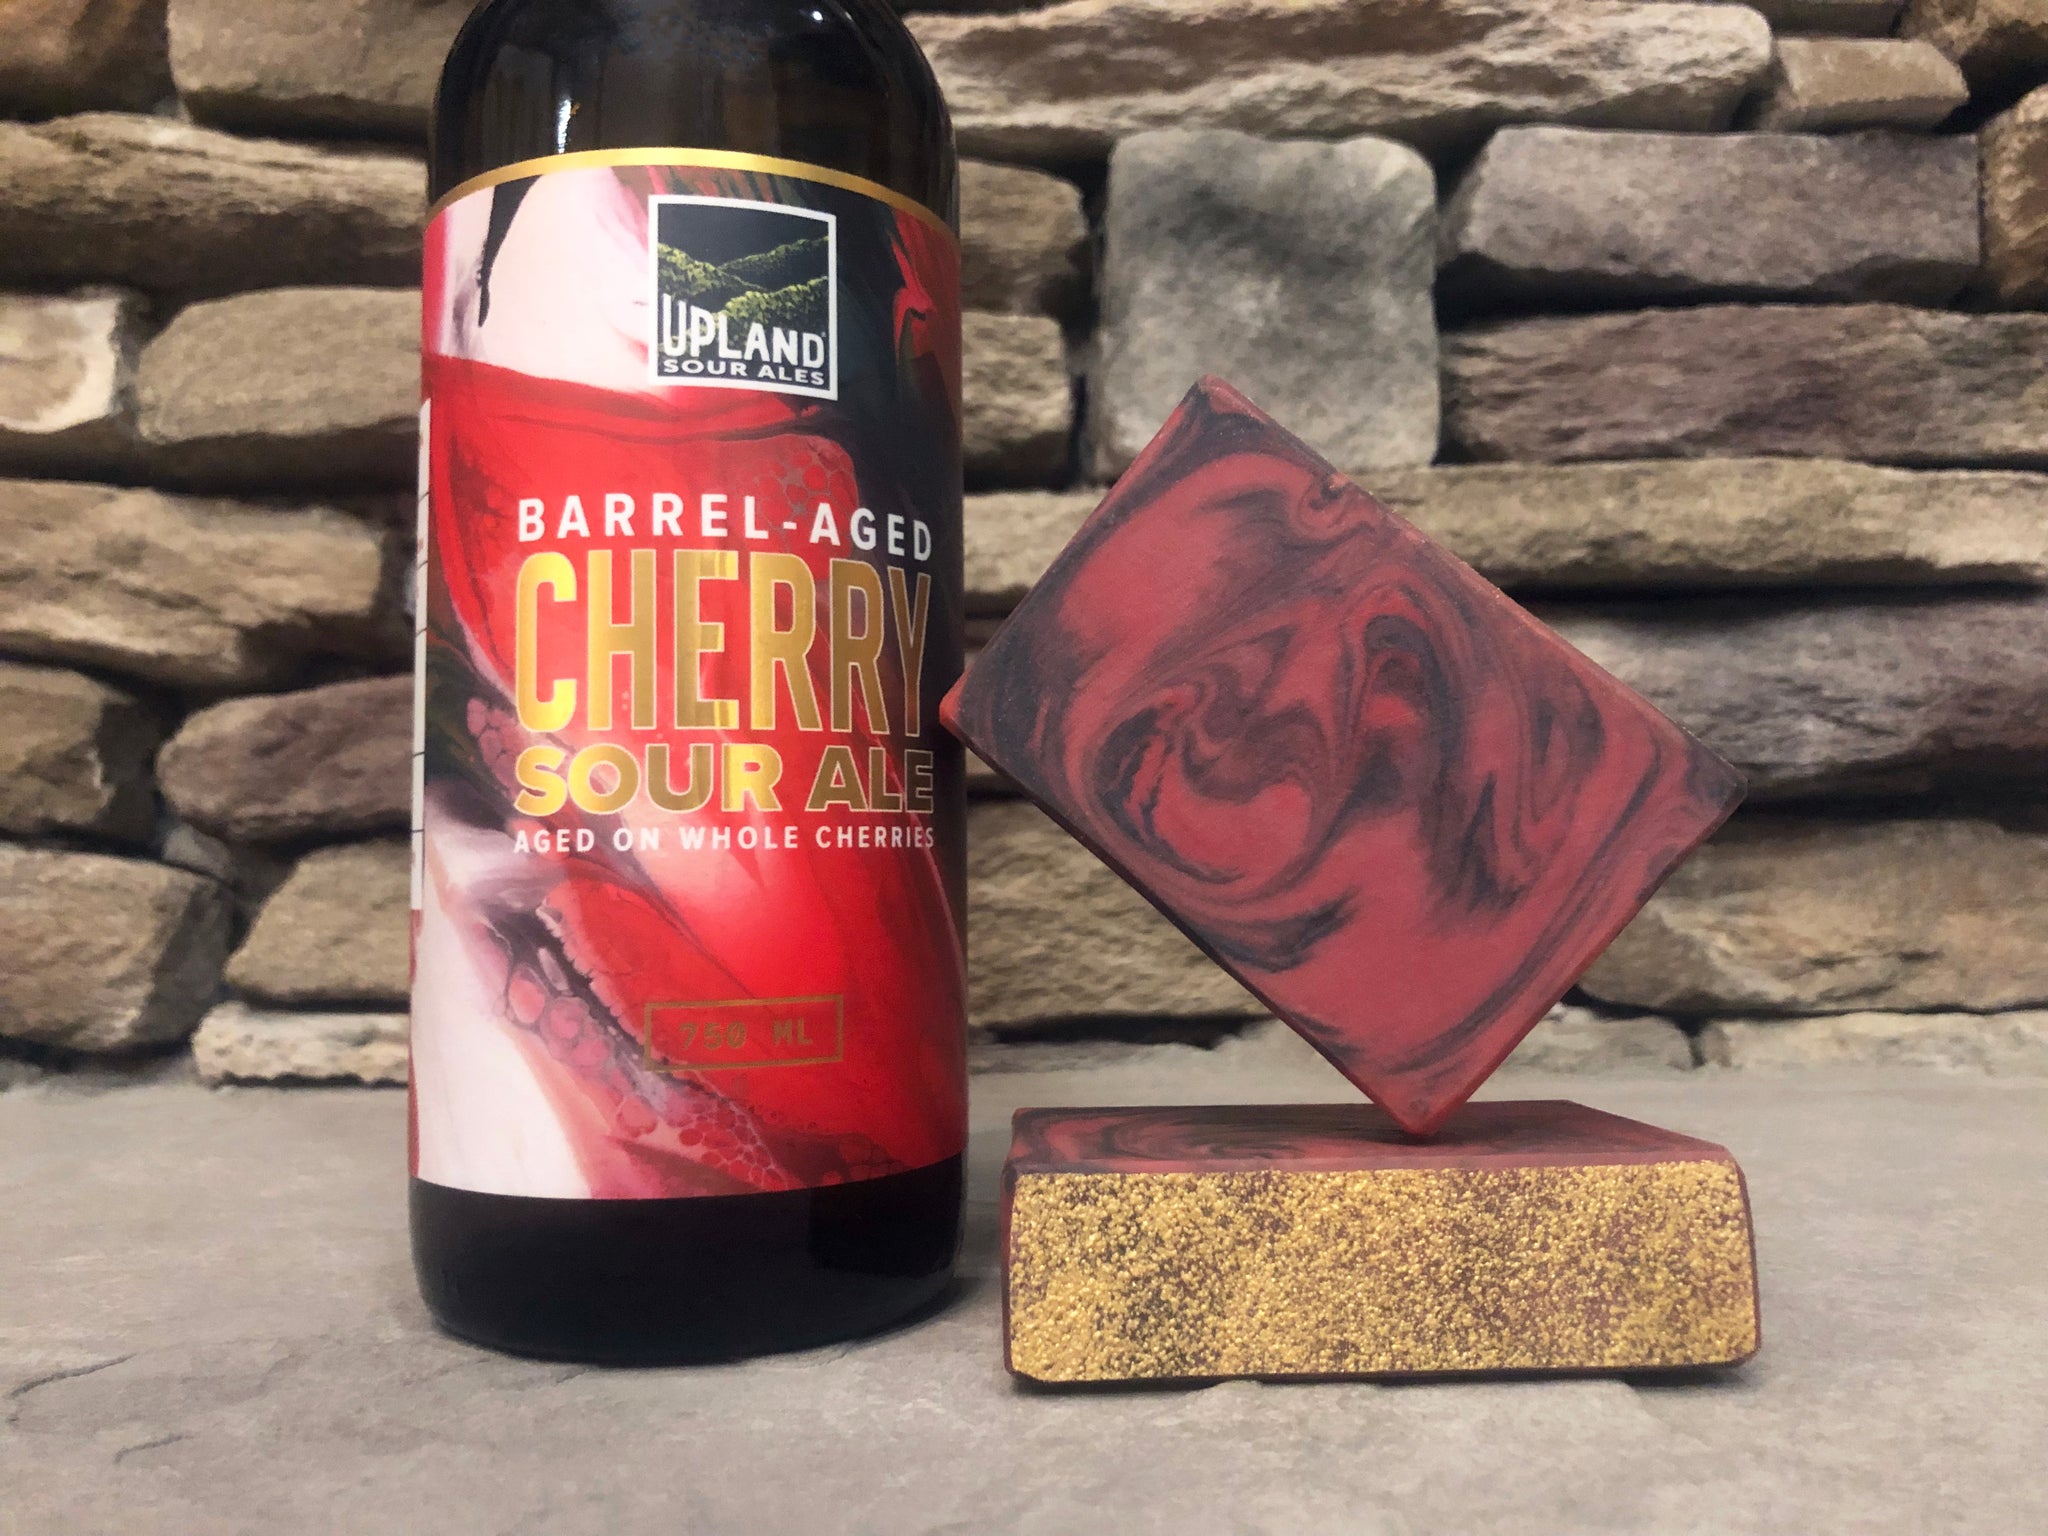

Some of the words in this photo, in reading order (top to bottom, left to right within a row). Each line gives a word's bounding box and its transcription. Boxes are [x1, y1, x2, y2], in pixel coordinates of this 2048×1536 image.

[662, 293, 825, 369] UPLAND
[663, 359, 748, 377] SOUR
[757, 365, 825, 385] ALES
[518, 493, 932, 562] BARREL-AGED
[516, 549, 931, 738] CHERRY
[514, 744, 783, 816] SOUR
[805, 745, 934, 814] ALE
[514, 829, 595, 853] AGED
[613, 827, 660, 851] ON
[680, 825, 799, 850] WHOLE
[815, 825, 934, 849] CHERRIES
[679, 1021, 746, 1050] 750
[771, 1017, 814, 1047] ML
